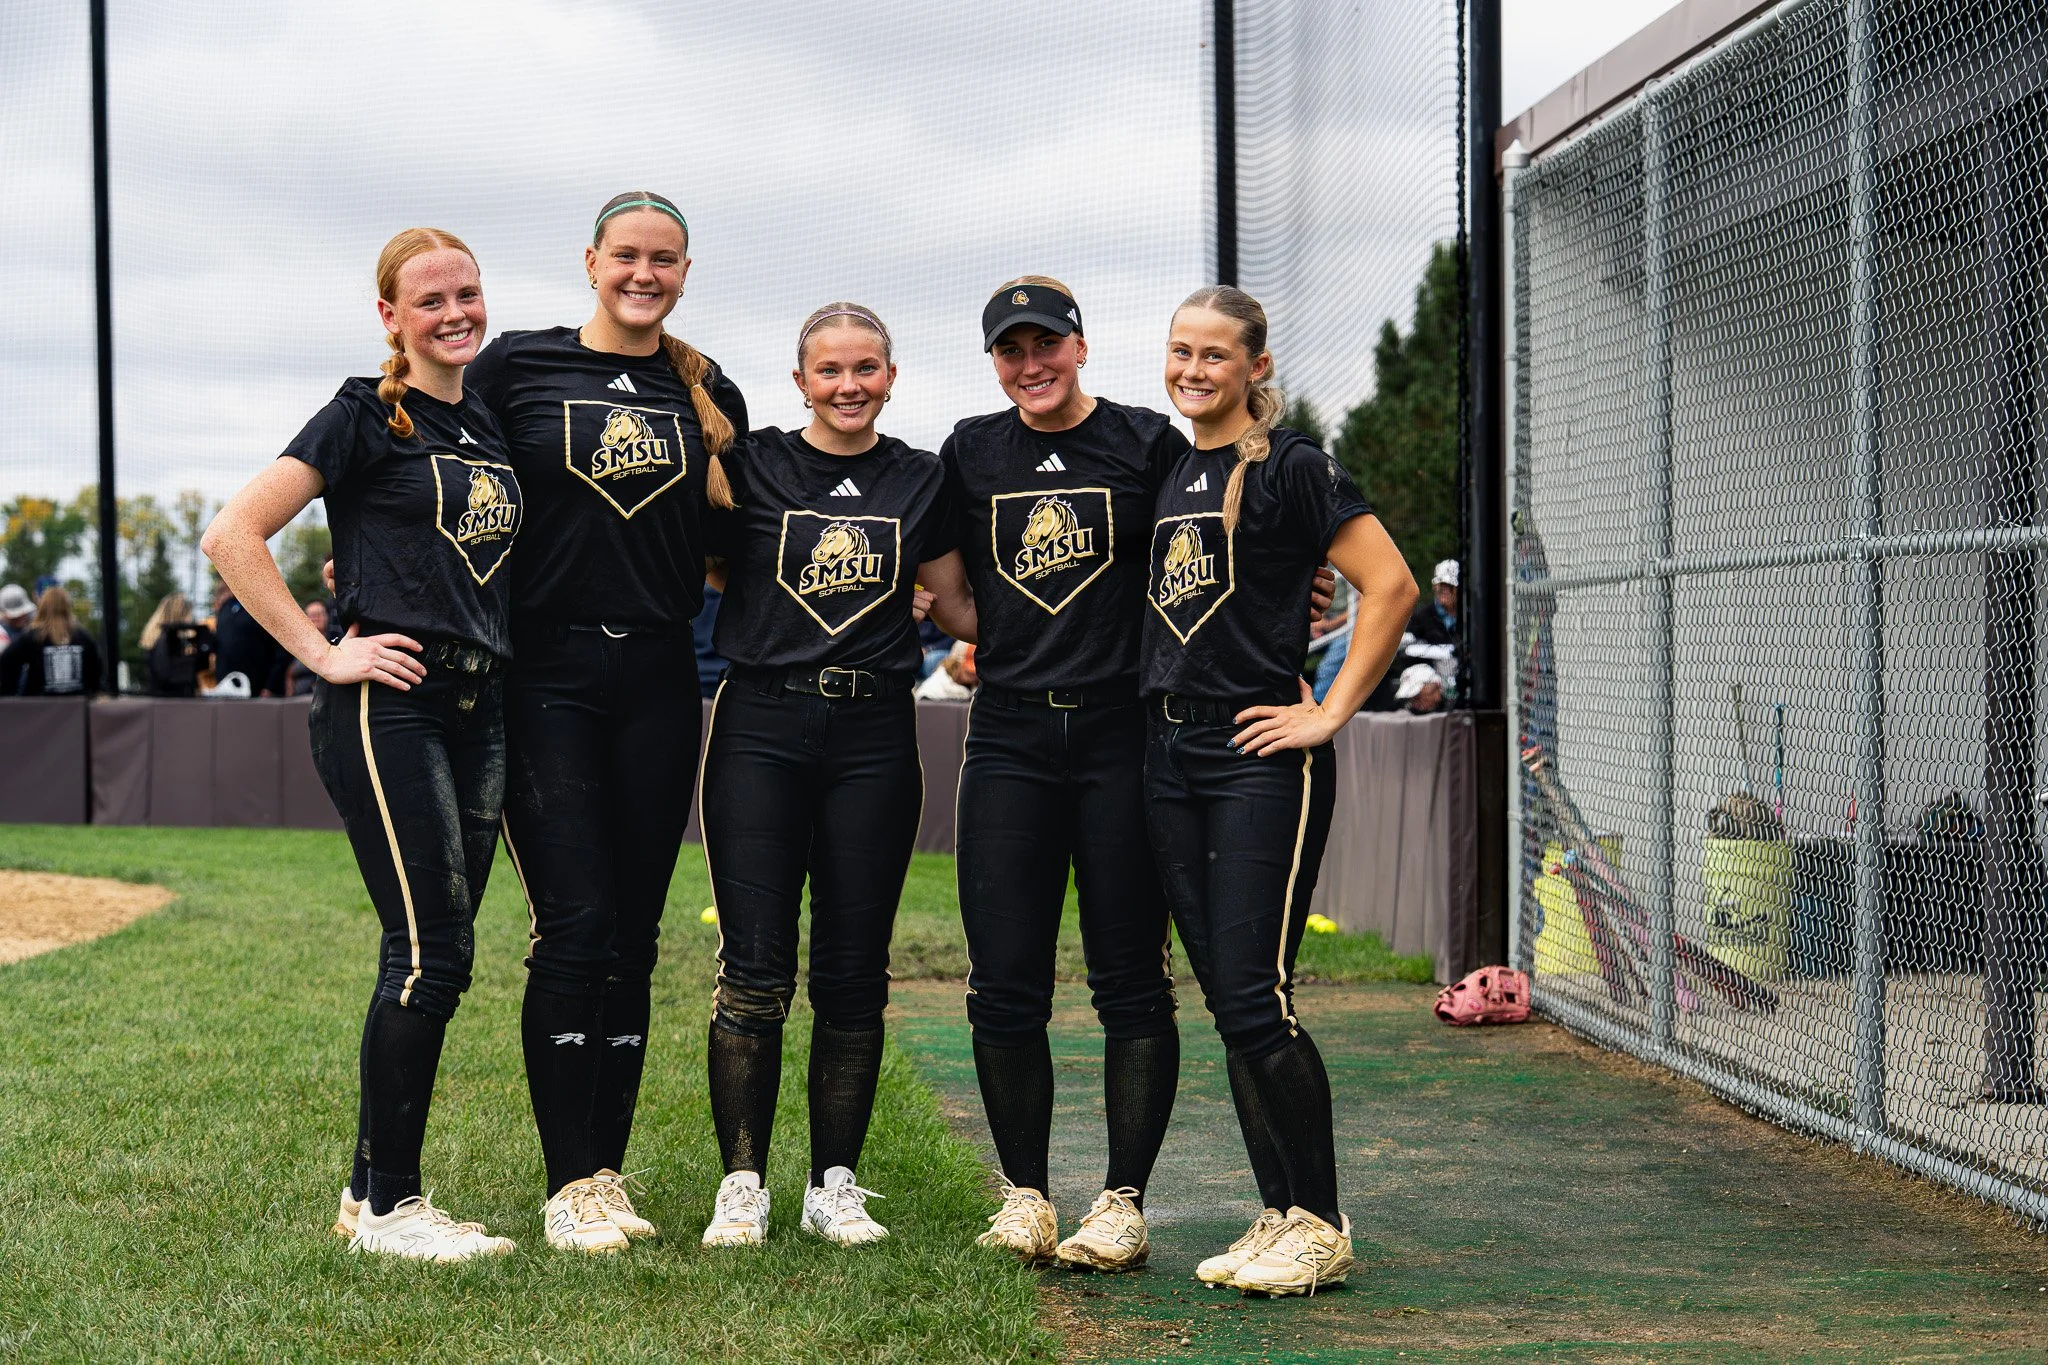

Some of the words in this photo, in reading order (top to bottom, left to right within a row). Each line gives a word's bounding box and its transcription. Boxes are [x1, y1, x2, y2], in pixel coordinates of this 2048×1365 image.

[592, 440, 671, 479] SMSU
[613, 466, 657, 480] SOFTBALL
[457, 505, 516, 541] SMSU
[471, 534, 501, 545] SOFTBALL
[1015, 528, 1095, 580] SMSU
[799, 554, 883, 595] SMSU
[1036, 560, 1080, 580] SOFTBALL
[1160, 554, 1216, 607] SMSU
[818, 584, 865, 598] SOFTBALL
[1173, 588, 1204, 608] SOFTBALL
